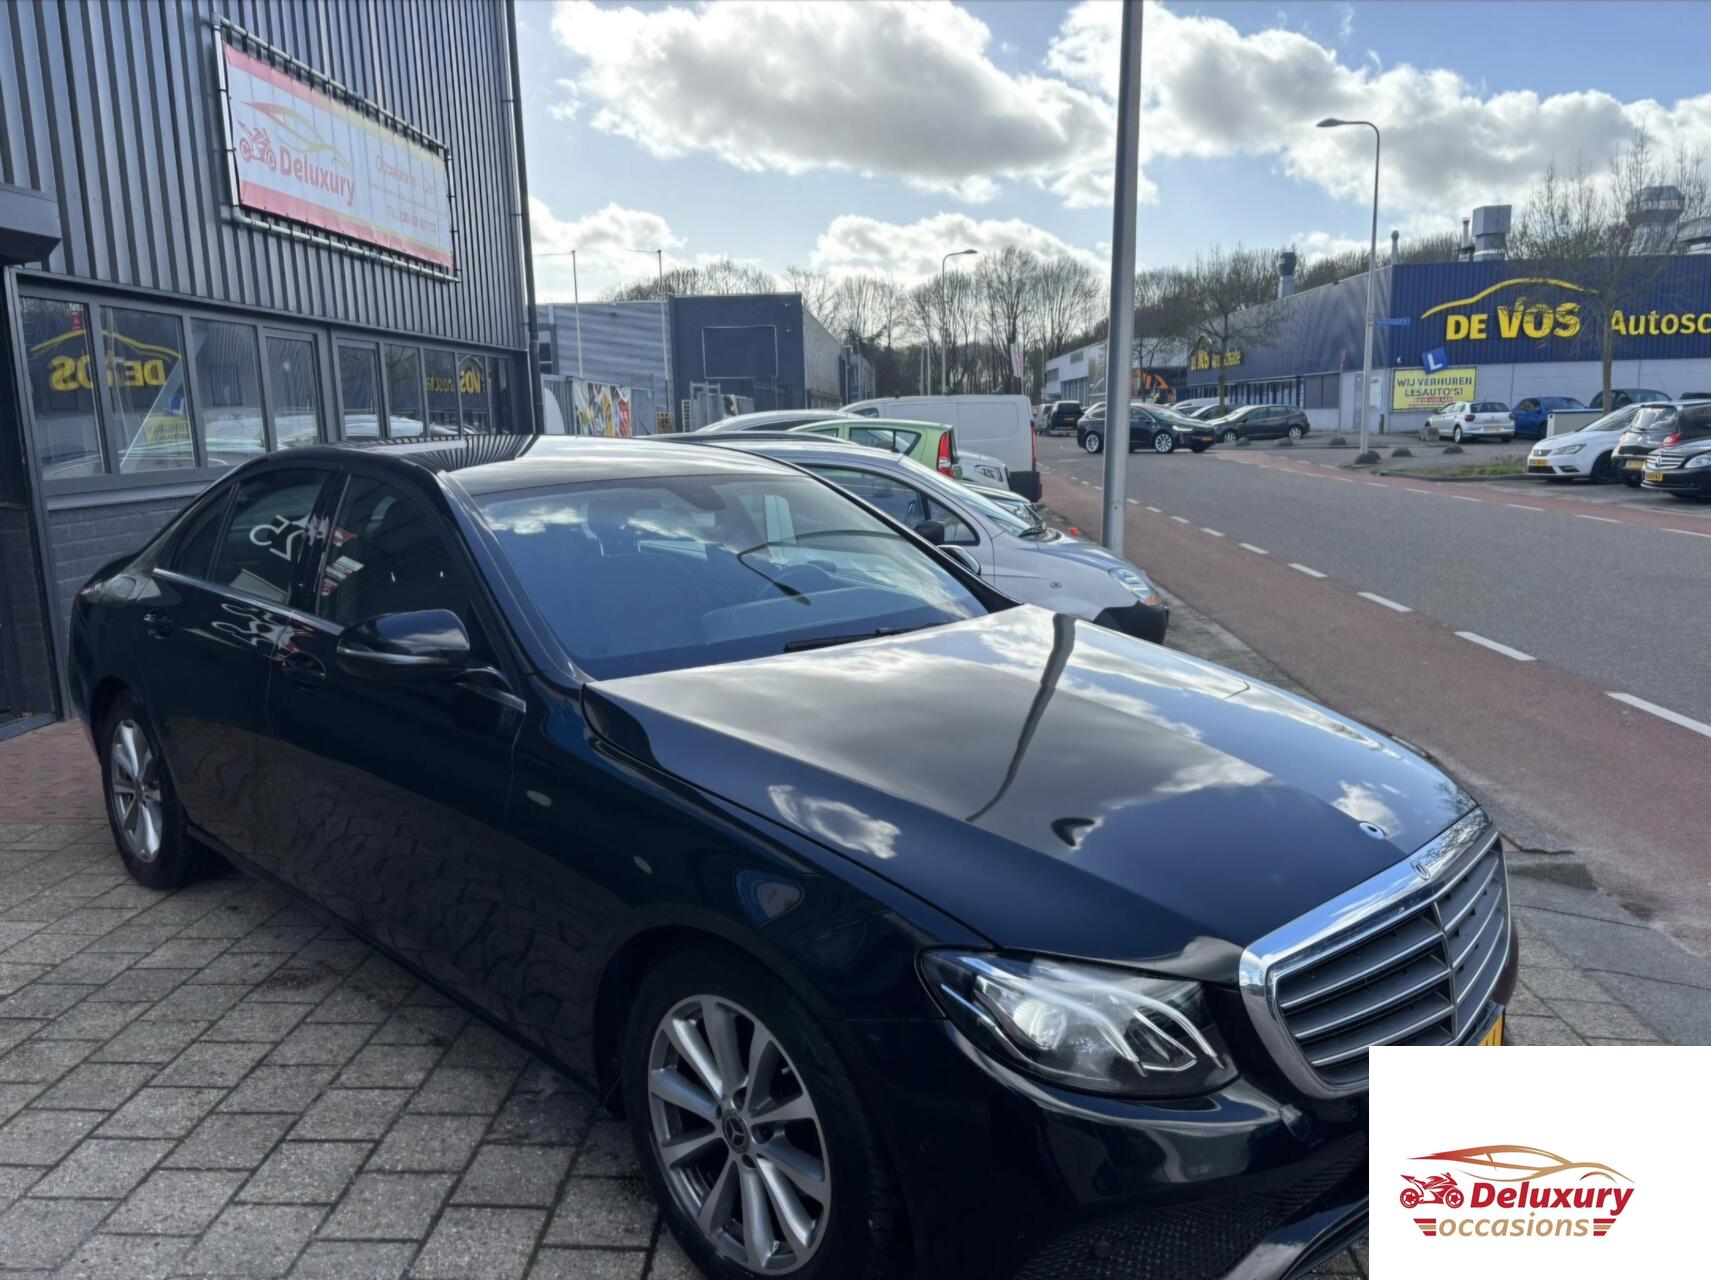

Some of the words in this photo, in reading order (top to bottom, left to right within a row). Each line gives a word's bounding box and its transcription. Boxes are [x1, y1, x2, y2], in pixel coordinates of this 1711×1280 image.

[280, 144, 355, 208] Deluxury
[1446, 314, 1489, 340] DE
[1497, 297, 1581, 338] VOS
[1612, 310, 1711, 335] Autosc
[1427, 353, 1443, 371] L
[1397, 377, 1416, 387] WIJ
[1417, 376, 1472, 386] VERHUREN
